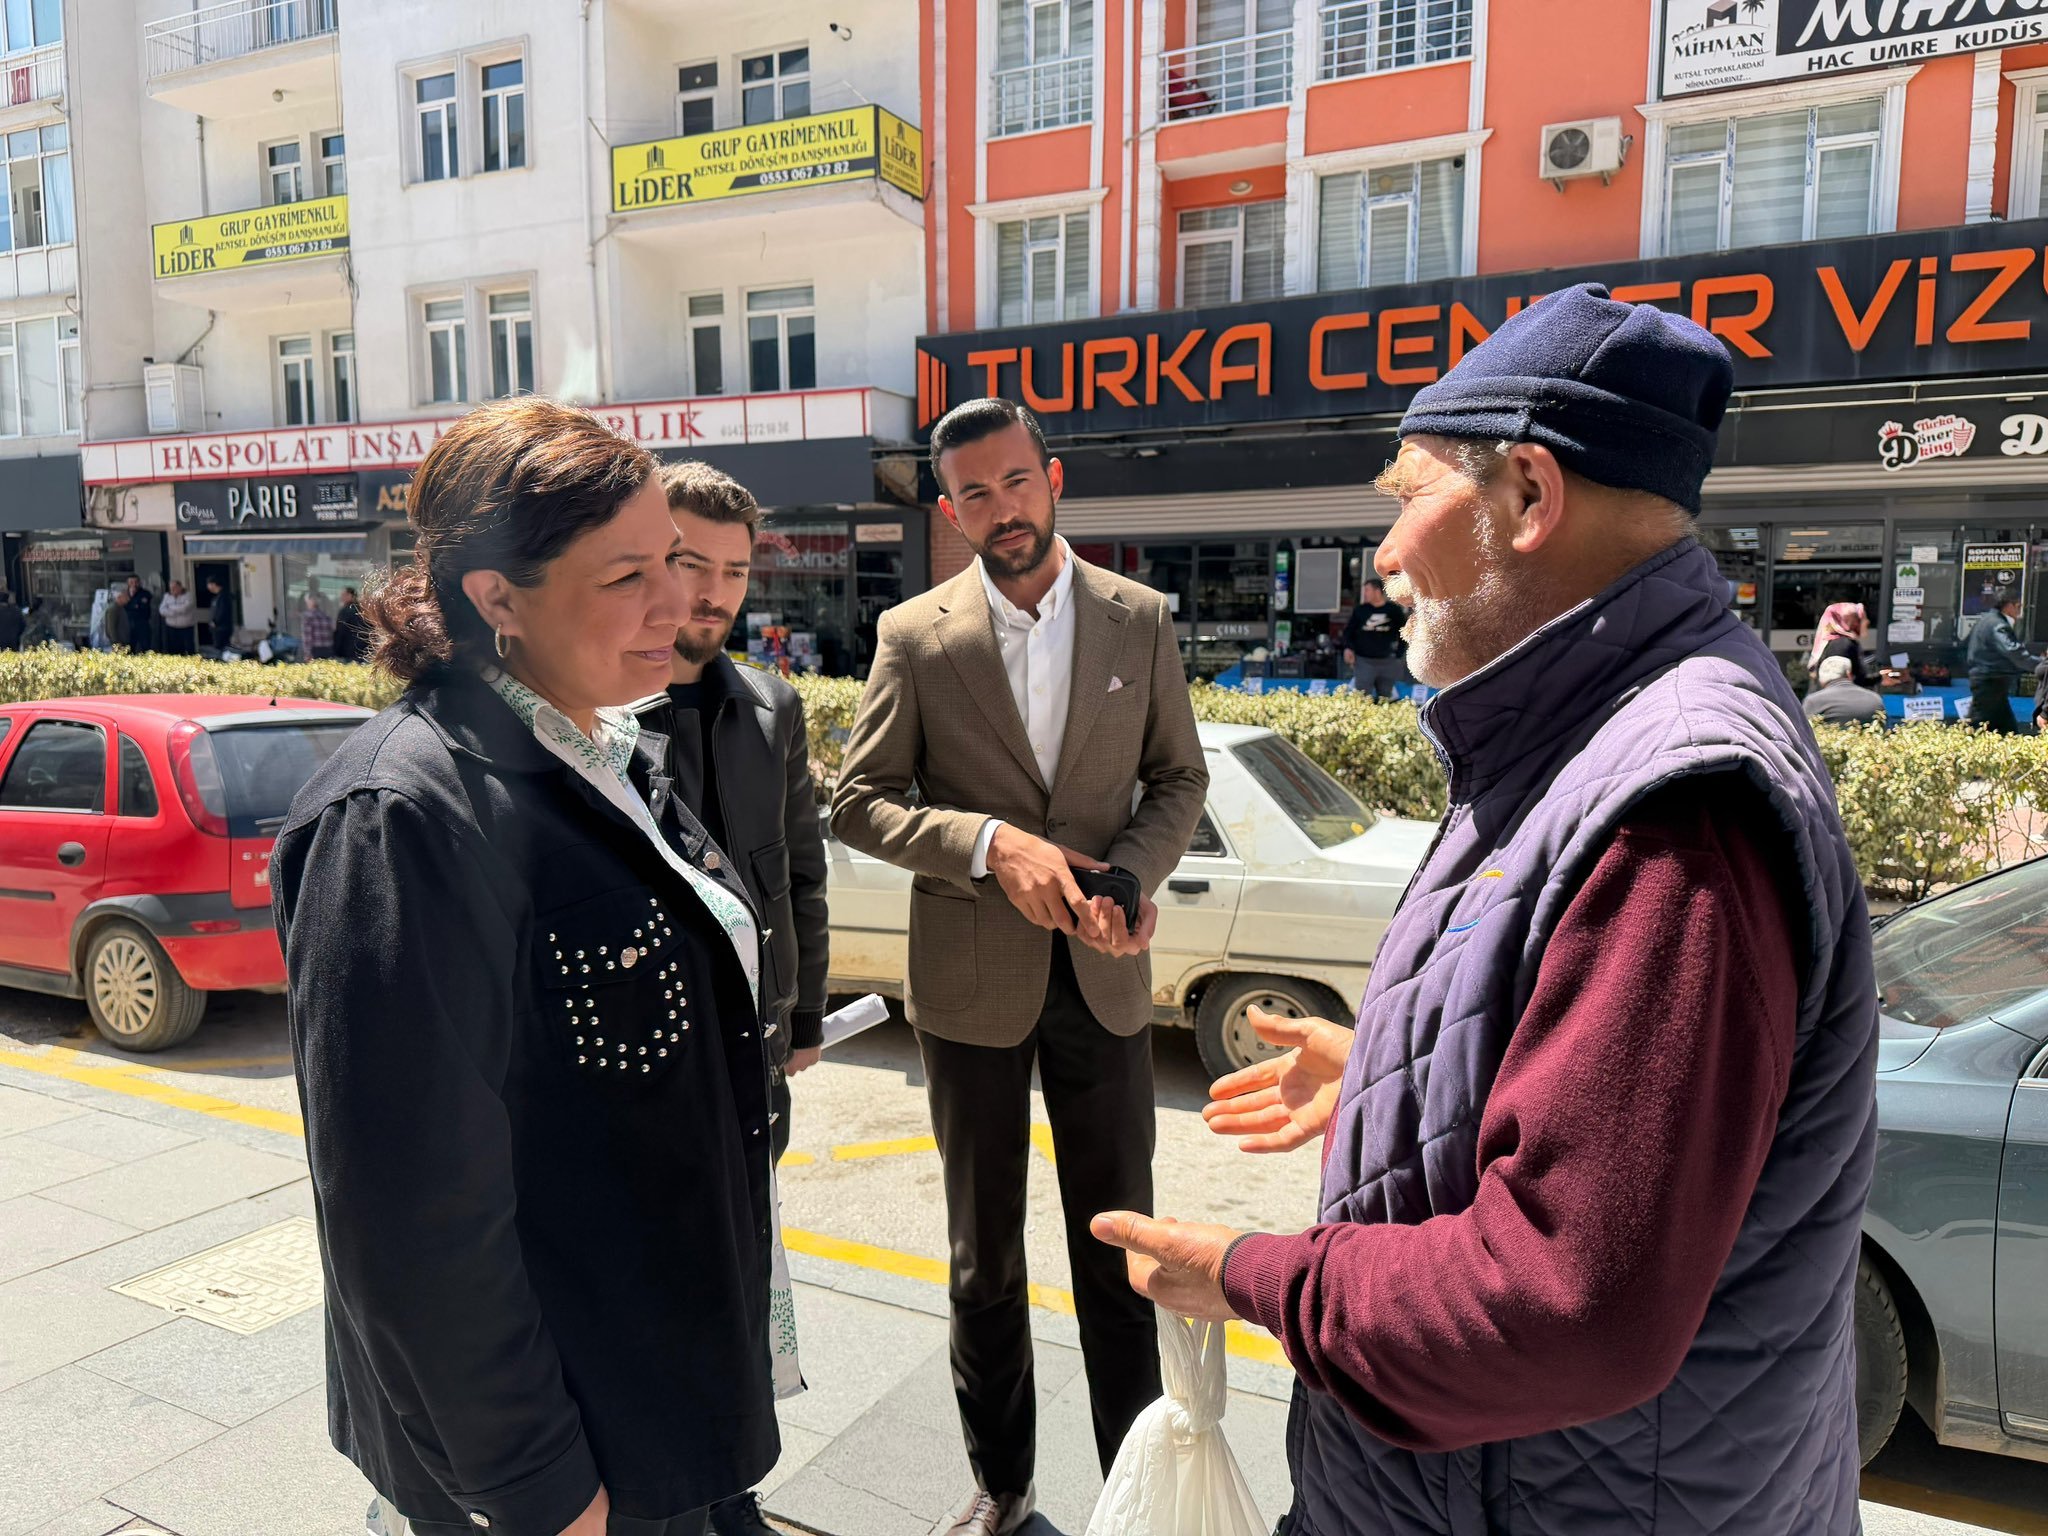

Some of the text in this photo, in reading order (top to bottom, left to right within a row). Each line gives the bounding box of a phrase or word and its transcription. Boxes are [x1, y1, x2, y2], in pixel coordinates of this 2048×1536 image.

[1673, 32, 1764, 62] MİHMAN
[1807, 20, 2043, 71] HAC UMRE KUDÜS
[1674, 69, 1701, 80] KUTSAL
[700, 118, 859, 160] GRUP GAYRİMENKUL
[694, 160, 736, 177] KENTSEL
[740, 151, 788, 171] DÖNÜŞÜM
[760, 161, 849, 185] 0553 067 32 82
[220, 205, 338, 237] GRUP GAYRİMENKUL
[215, 239, 248, 251] KENTSEL
[289, 244, 305, 255] 067
[967, 322, 1272, 413] TURKA
[1309, 273, 1773, 390] CENR
[162, 436, 333, 470] HASPOLAT
[351, 429, 441, 462] İNŞA
[1920, 441, 1953, 457] king
